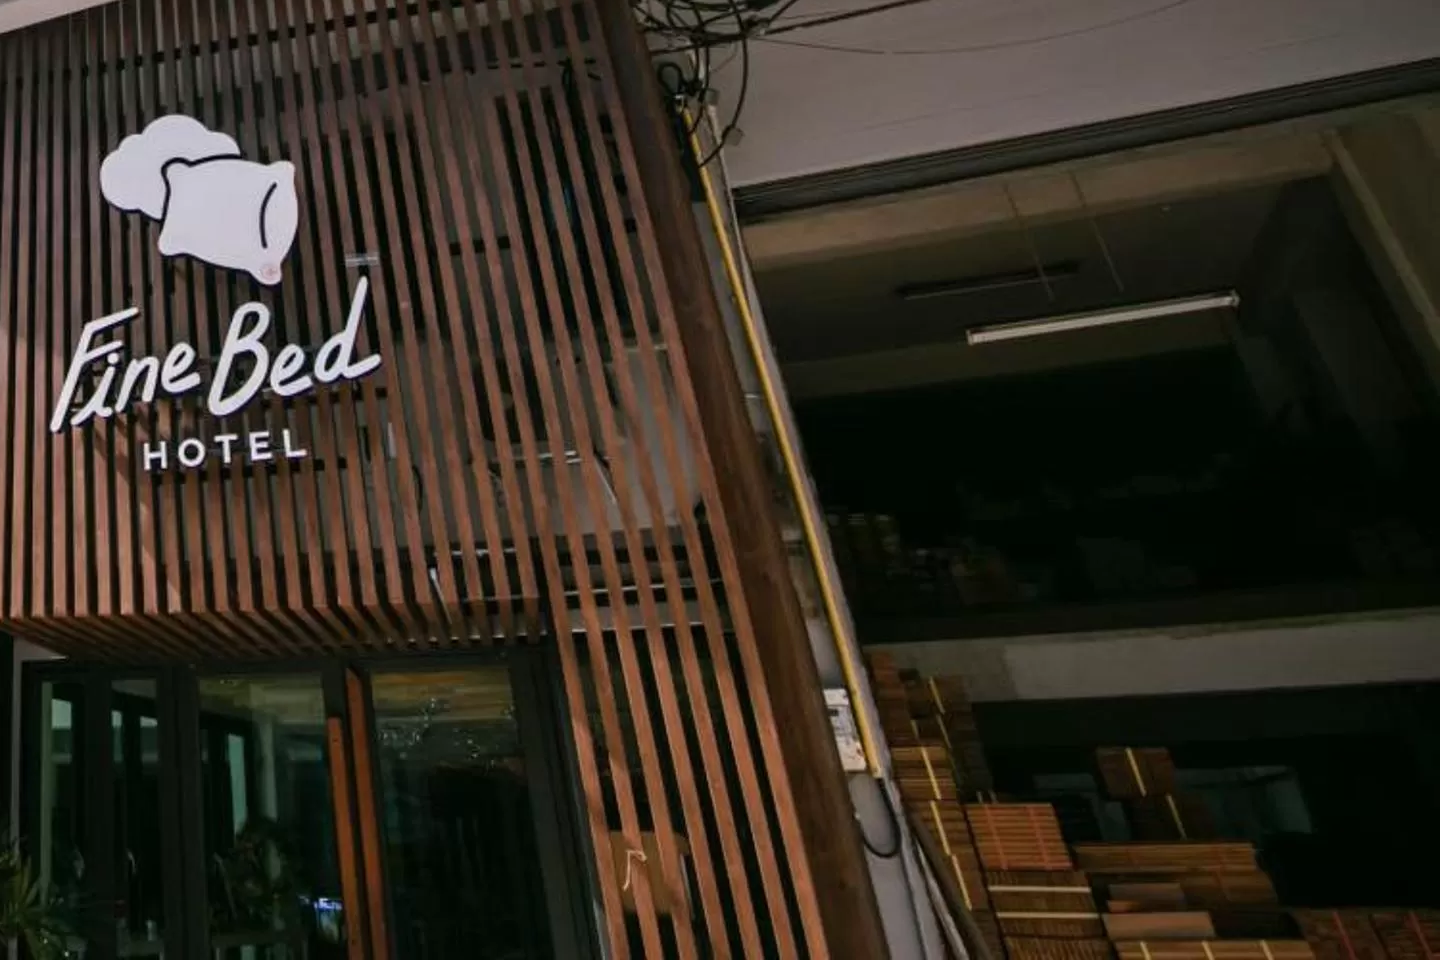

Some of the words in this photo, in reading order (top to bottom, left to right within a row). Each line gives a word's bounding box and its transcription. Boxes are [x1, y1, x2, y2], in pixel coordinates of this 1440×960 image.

[50, 307, 201, 433] Fine
[208, 276, 381, 416] Bed
[143, 429, 307, 470] HOTEL
